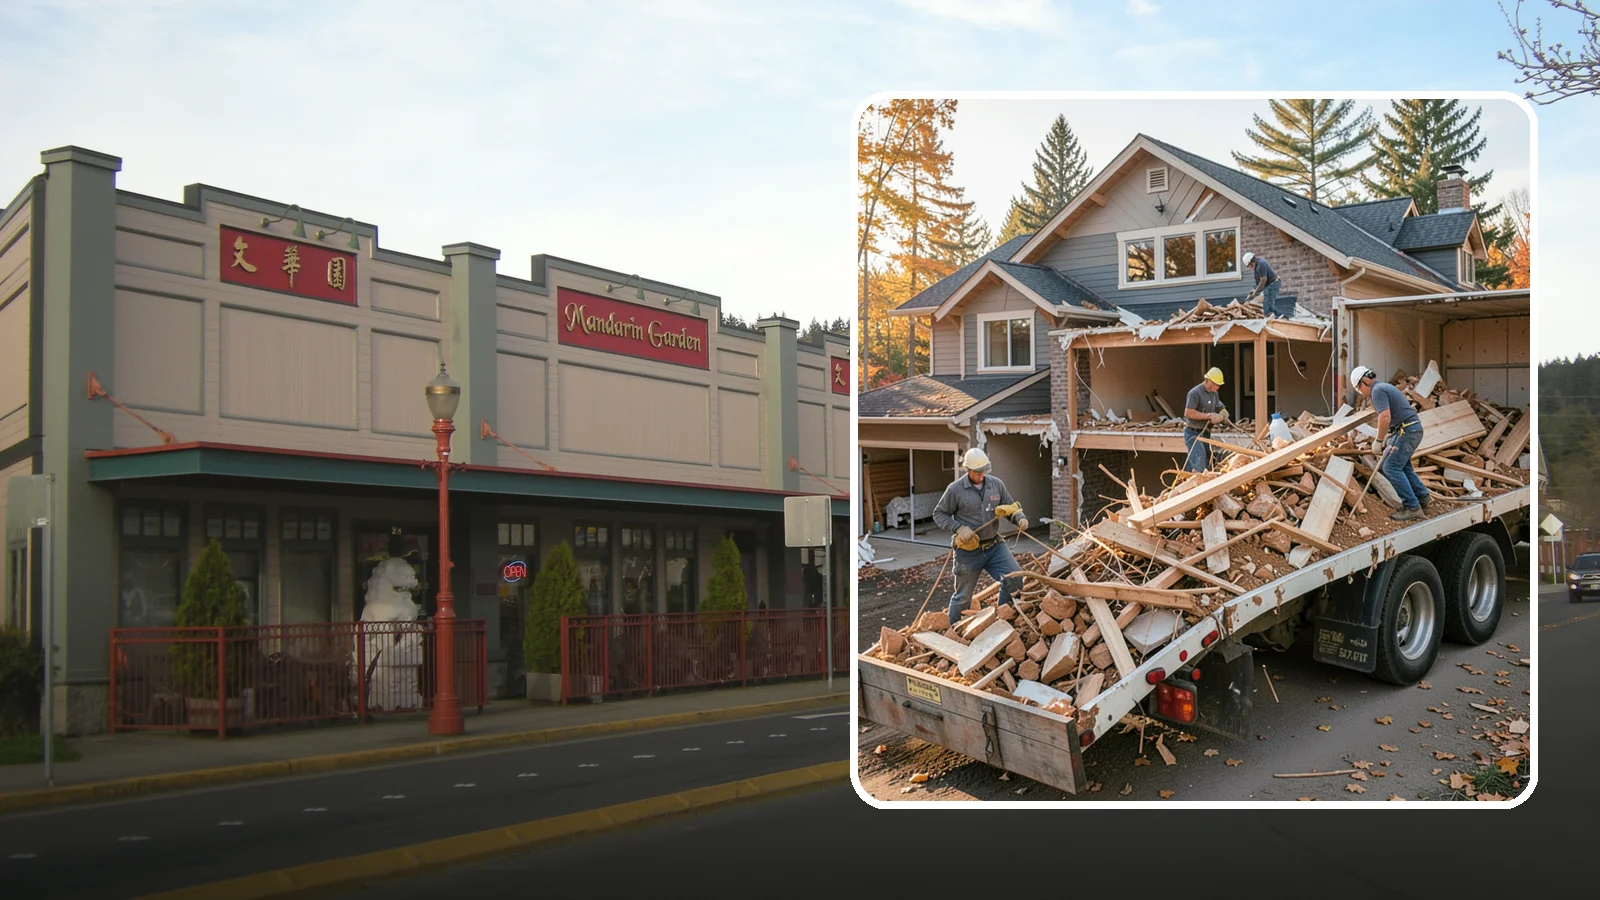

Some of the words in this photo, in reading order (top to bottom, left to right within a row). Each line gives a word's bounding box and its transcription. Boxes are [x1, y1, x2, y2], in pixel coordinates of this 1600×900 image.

[231, 235, 347, 291] 文華園
[564, 302, 644, 341] Mandarin
[647, 320, 701, 352] Garden
[503, 565, 527, 578] OPEN
